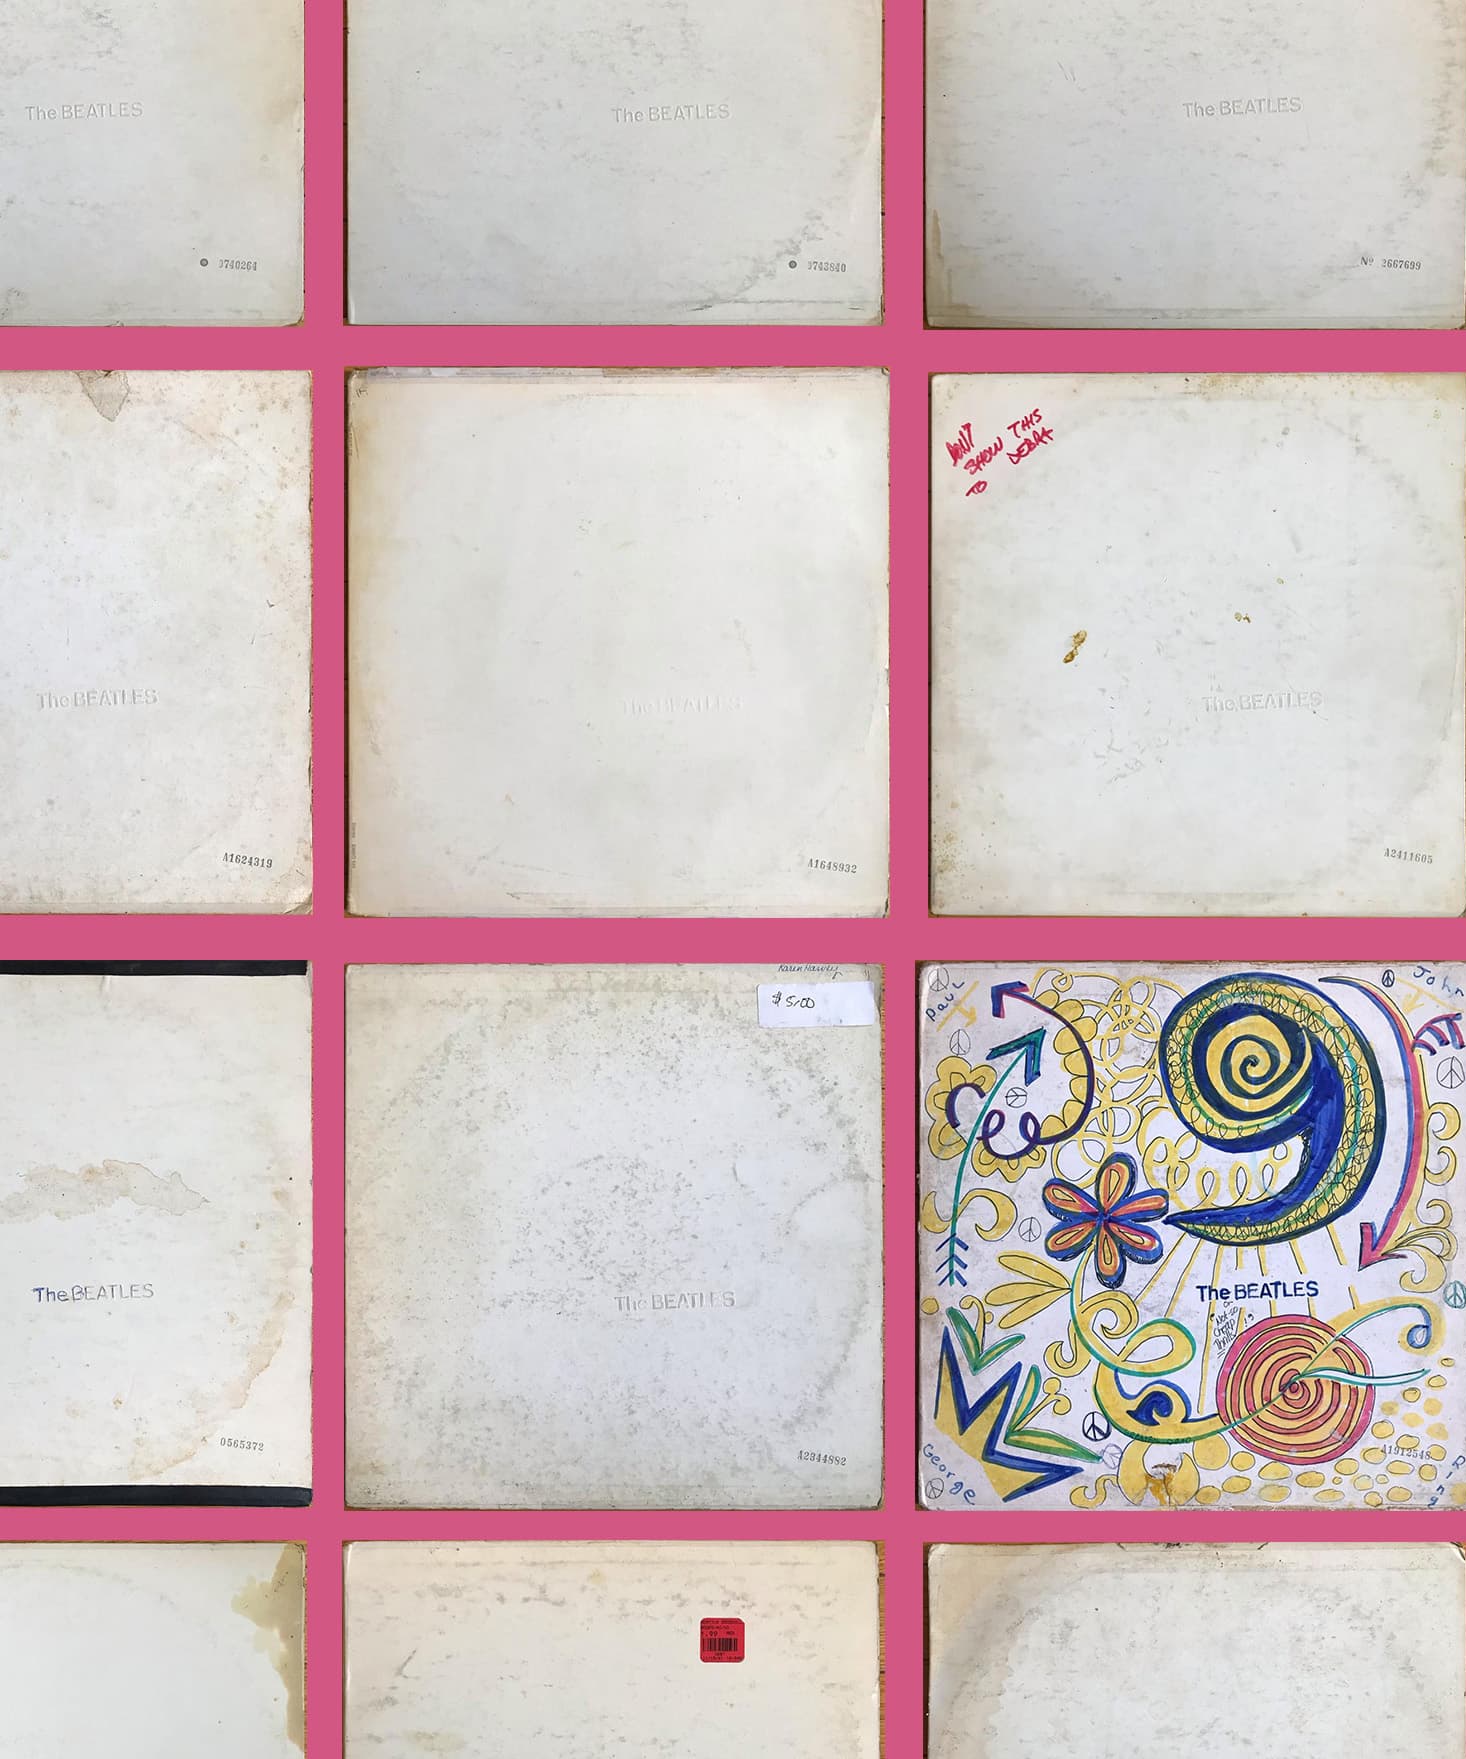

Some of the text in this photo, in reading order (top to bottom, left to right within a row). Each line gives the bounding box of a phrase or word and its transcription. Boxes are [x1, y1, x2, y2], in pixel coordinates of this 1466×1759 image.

[24, 101, 144, 121] The BEATLES
[612, 103, 731, 123] The BEATLES
[1182, 96, 1302, 119] The BEATLES
[963, 408, 1043, 476] SHOW THIS
[965, 480, 988, 497] TO
[36, 688, 160, 711] The BEATLES
[1202, 691, 1323, 713] The BEATLES
[221, 852, 272, 869] A1624319
[807, 857, 856, 875] A1648932
[1383, 847, 1433, 865] A2411605
[32, 1282, 155, 1304] The BEATLES
[613, 1290, 736, 1313] The BEATLES
[1196, 1280, 1320, 1303] The BEATLES
[219, 1436, 265, 1453] 0565372
[922, 1443, 978, 1506] George
